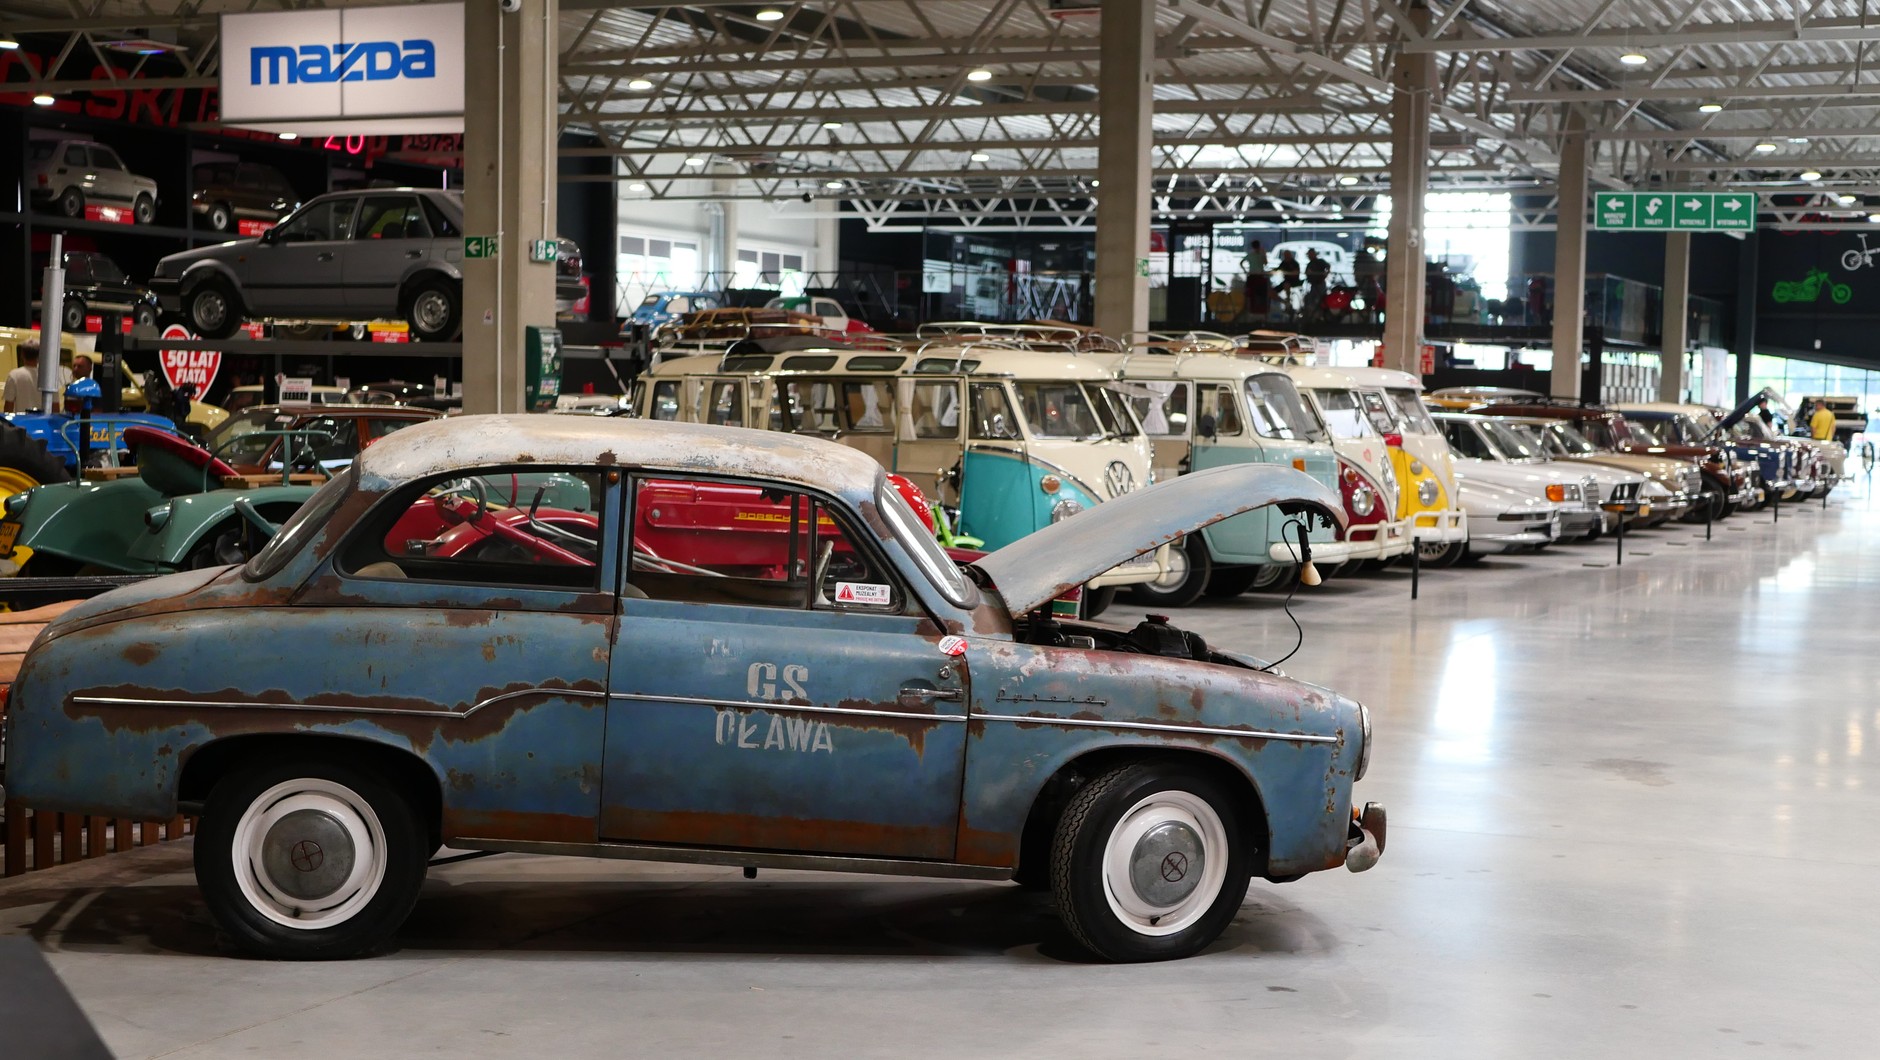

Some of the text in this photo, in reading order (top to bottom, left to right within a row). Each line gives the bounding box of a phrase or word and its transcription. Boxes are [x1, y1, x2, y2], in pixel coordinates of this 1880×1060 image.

[166, 349, 188, 368] 50
[188, 350, 216, 369] LAT
[174, 368, 207, 384] FIATA
[738, 511, 791, 523] PORSCH
[747, 662, 809, 700] GS
[715, 709, 833, 754] OŁAWA
